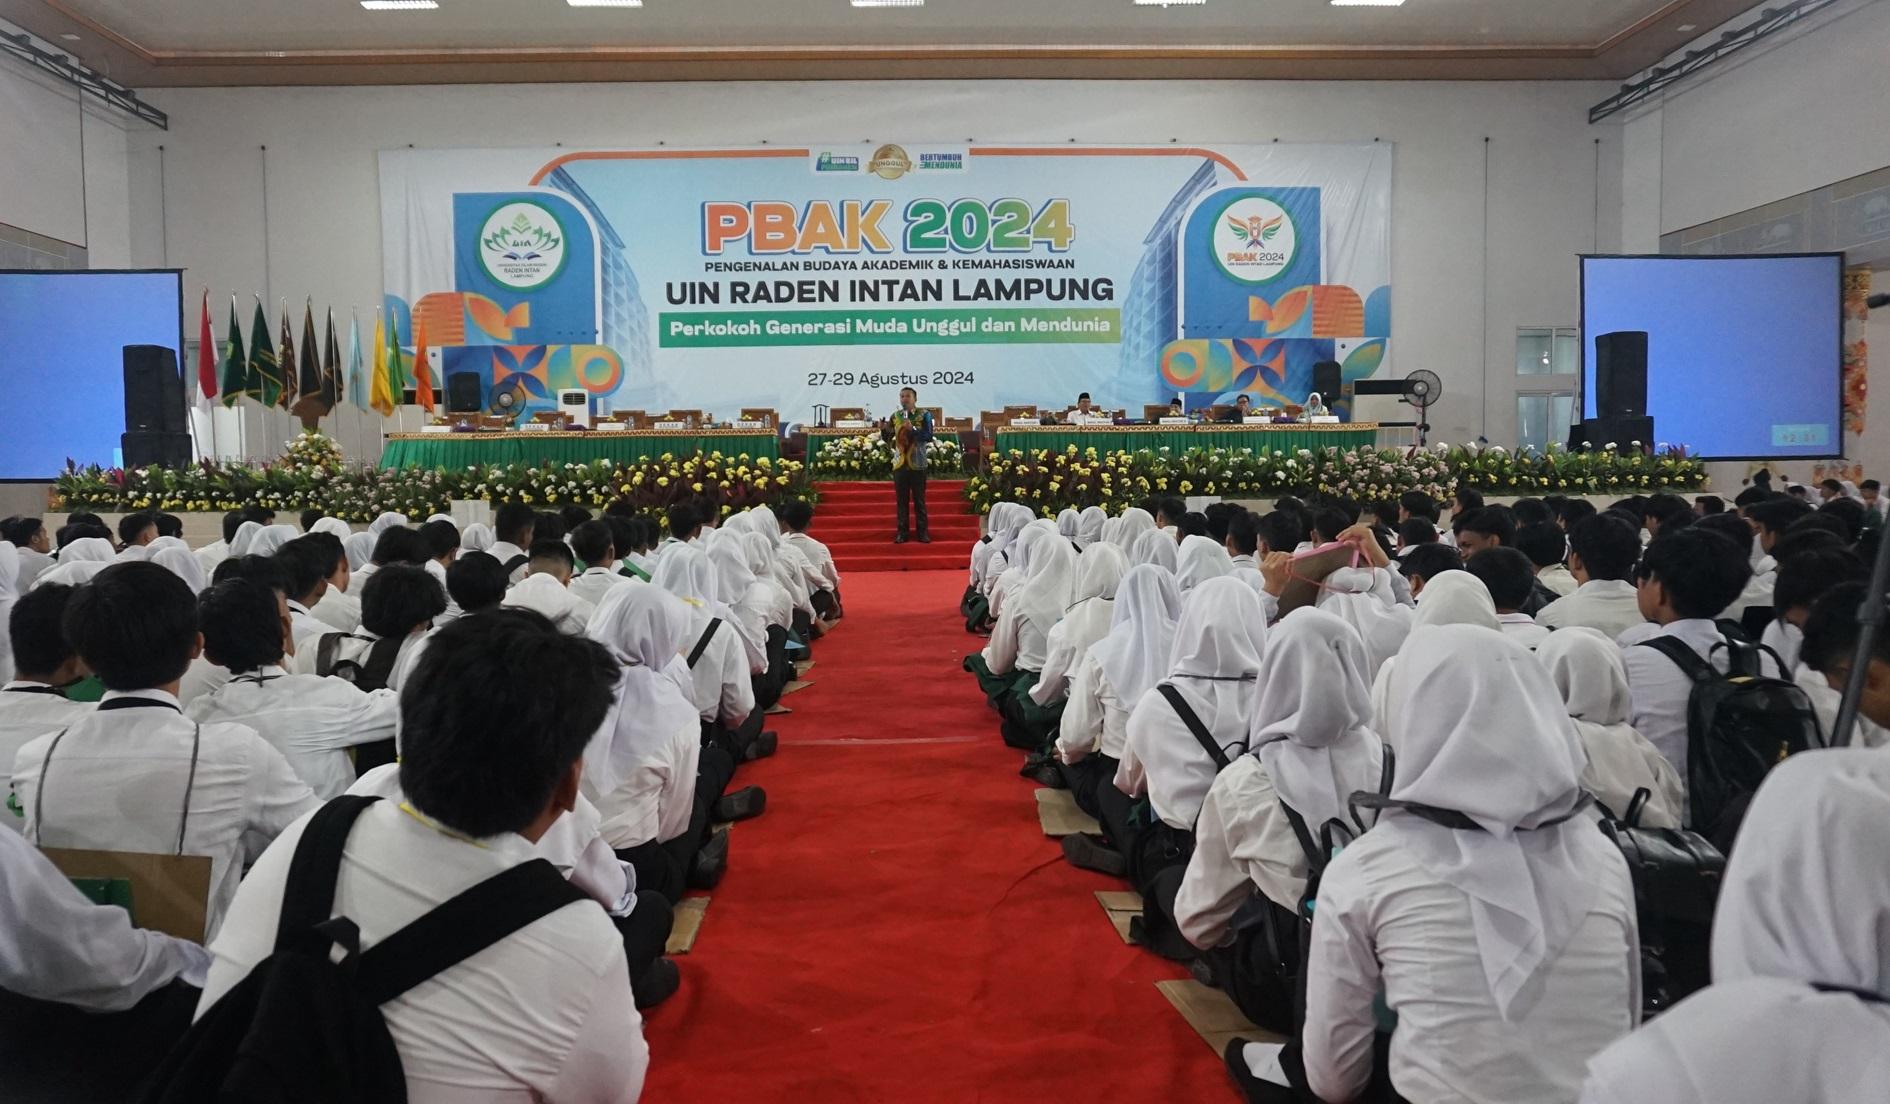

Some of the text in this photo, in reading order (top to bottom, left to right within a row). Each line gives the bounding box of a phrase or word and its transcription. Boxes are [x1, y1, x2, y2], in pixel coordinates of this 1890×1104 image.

[919, 153, 962, 161] BERTUMBUH
[920, 161, 963, 169] MENDUNIA
[702, 198, 1075, 253] PBAK 2024
[1259, 253, 1284, 261] 2024
[704, 259, 1075, 272] PENGENALAN BUDAYA AKADEMIK & KEMAHASISWAAN
[666, 278, 1114, 305] UIN RADEN INTAN LAMPUNG
[670, 316, 1111, 336] Perkokoh Generasi Muda Unggul dan Mendunia
[807, 371, 975, 388] 27-29 Agustus 2024
